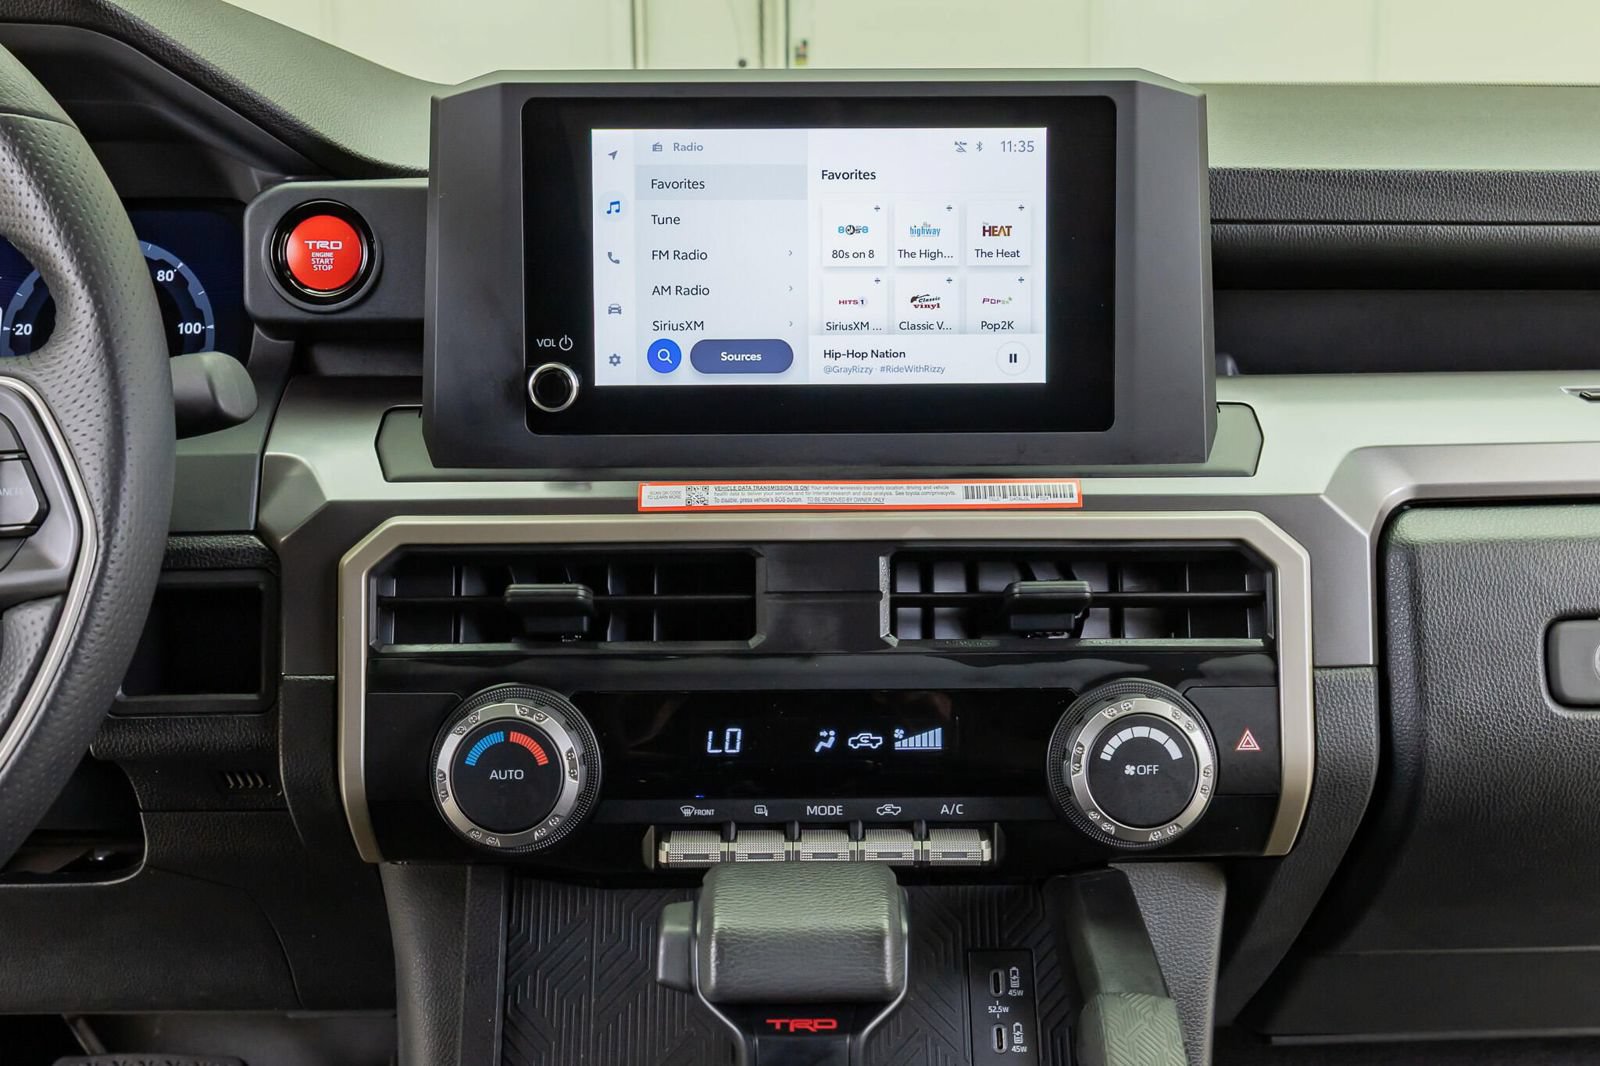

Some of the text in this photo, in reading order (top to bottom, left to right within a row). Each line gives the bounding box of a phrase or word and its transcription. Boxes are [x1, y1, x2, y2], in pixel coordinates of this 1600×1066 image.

[673, 142, 704, 152] Radio
[1000, 141, 1035, 152] 11:35
[821, 169, 877, 180] Favorites
[651, 179, 705, 190] Favorites
[651, 214, 681, 225] Tune
[910, 225, 941, 238] highway
[982, 225, 1013, 238] HEAT
[304, 240, 343, 250] TRD
[652, 249, 708, 260] FM Radio
[832, 250, 850, 259] 80s
[867, 250, 875, 259] 8
[898, 249, 954, 261] The High...
[975, 248, 1020, 258] The Heat
[156, 269, 175, 282] 80
[652, 284, 710, 296] AM Radio
[913, 302, 941, 310] vinyl
[14, 324, 33, 336] 20
[177, 322, 202, 335] 100
[652, 320, 705, 332] SiriusXM
[825, 321, 870, 332] SiriusXM
[899, 321, 934, 331] Classic
[980, 320, 1014, 333] Pop2K
[536, 338, 557, 347] VOL
[720, 352, 762, 362] Sources
[823, 349, 906, 361] Hip-Hop Nation
[823, 365, 945, 375] @GrayRizzy #RideWithRizzy
[489, 769, 525, 780] AUTO
[1136, 764, 1160, 776] OFF
[694, 808, 715, 816] FRONT
[806, 804, 844, 816] MODE
[940, 803, 964, 816] A/C
[1008, 989, 1024, 997] 45W
[988, 1005, 1010, 1014] 52.5W
[765, 1019, 838, 1033] TRD
[1011, 1045, 1028, 1053] 45W
